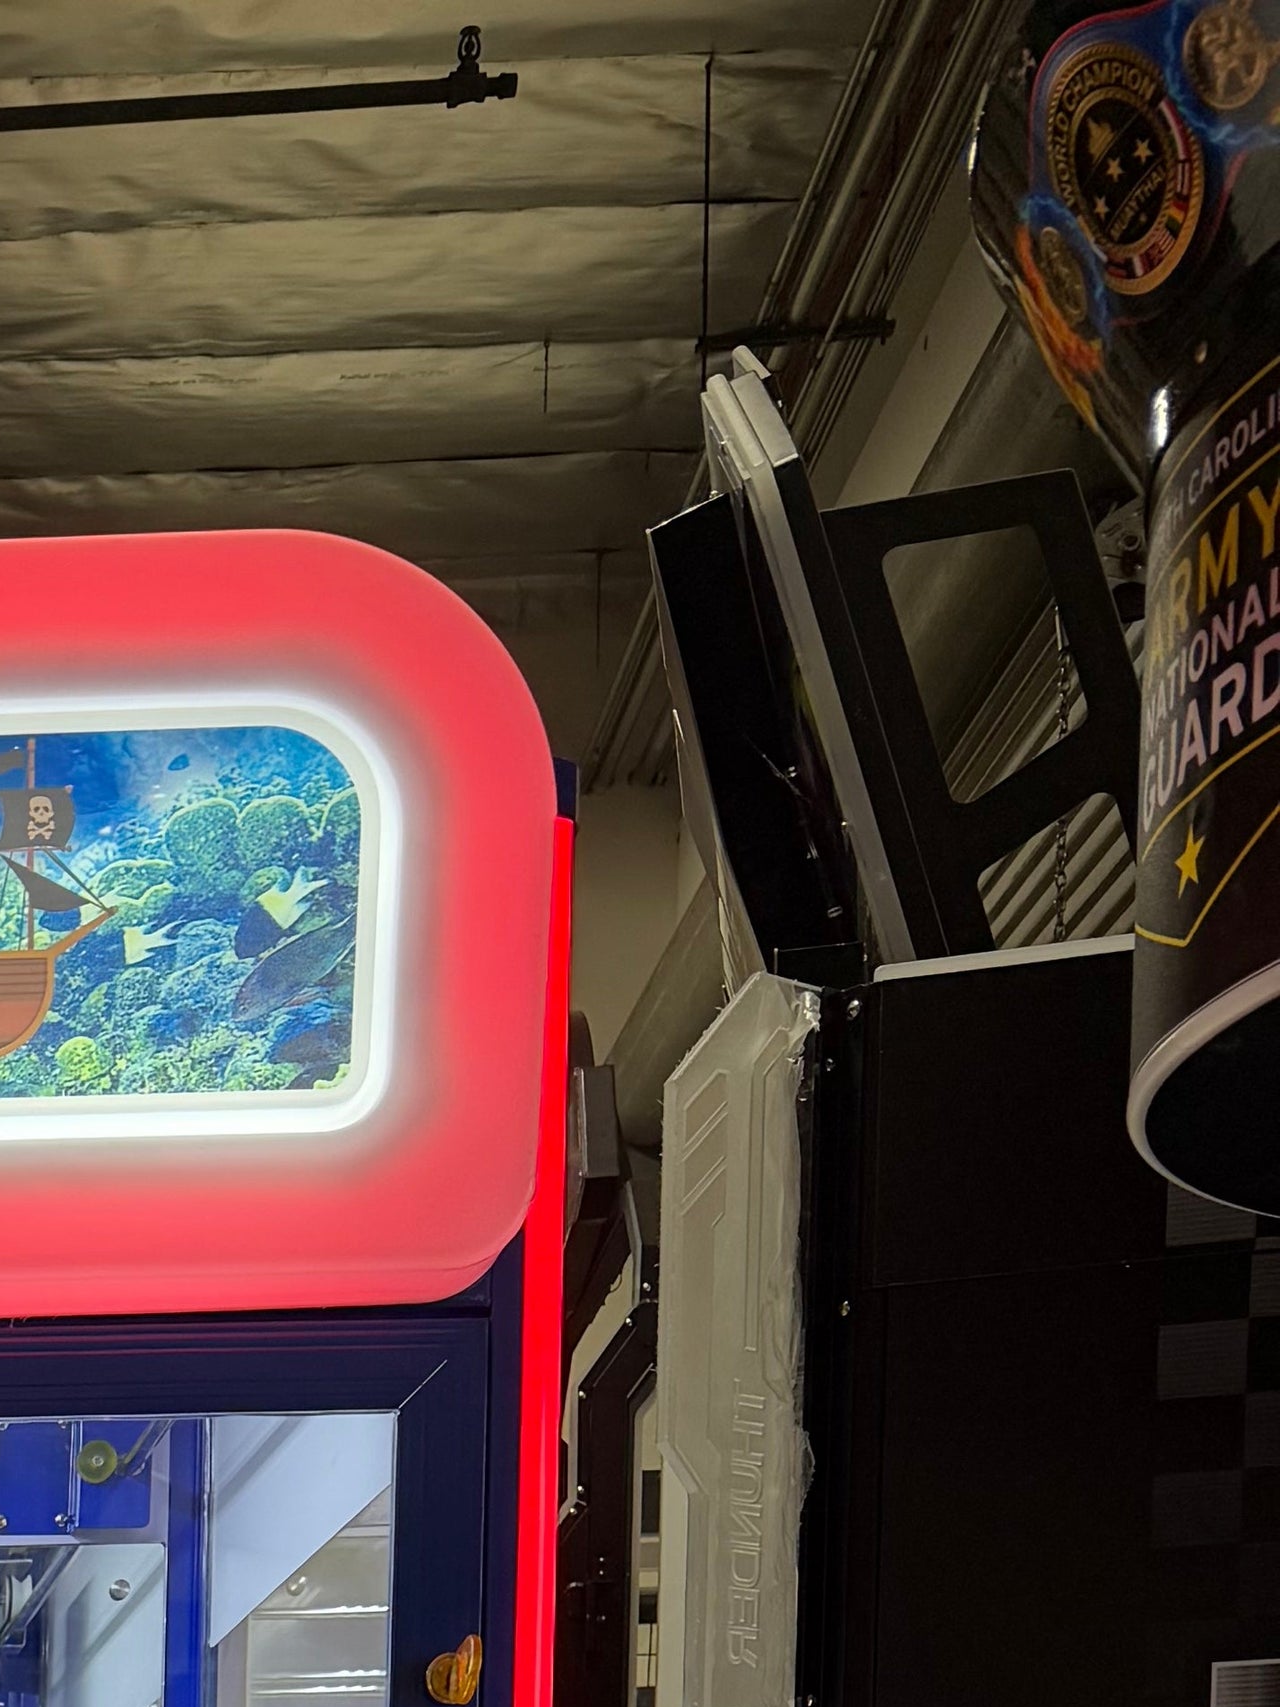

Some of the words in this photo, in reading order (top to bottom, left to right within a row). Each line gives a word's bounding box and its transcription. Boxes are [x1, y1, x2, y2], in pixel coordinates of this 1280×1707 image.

[1061, 60, 1158, 113] CHAMPION
[1054, 110, 1077, 209] WORLD
[1188, 390, 1280, 505] CAROLI
